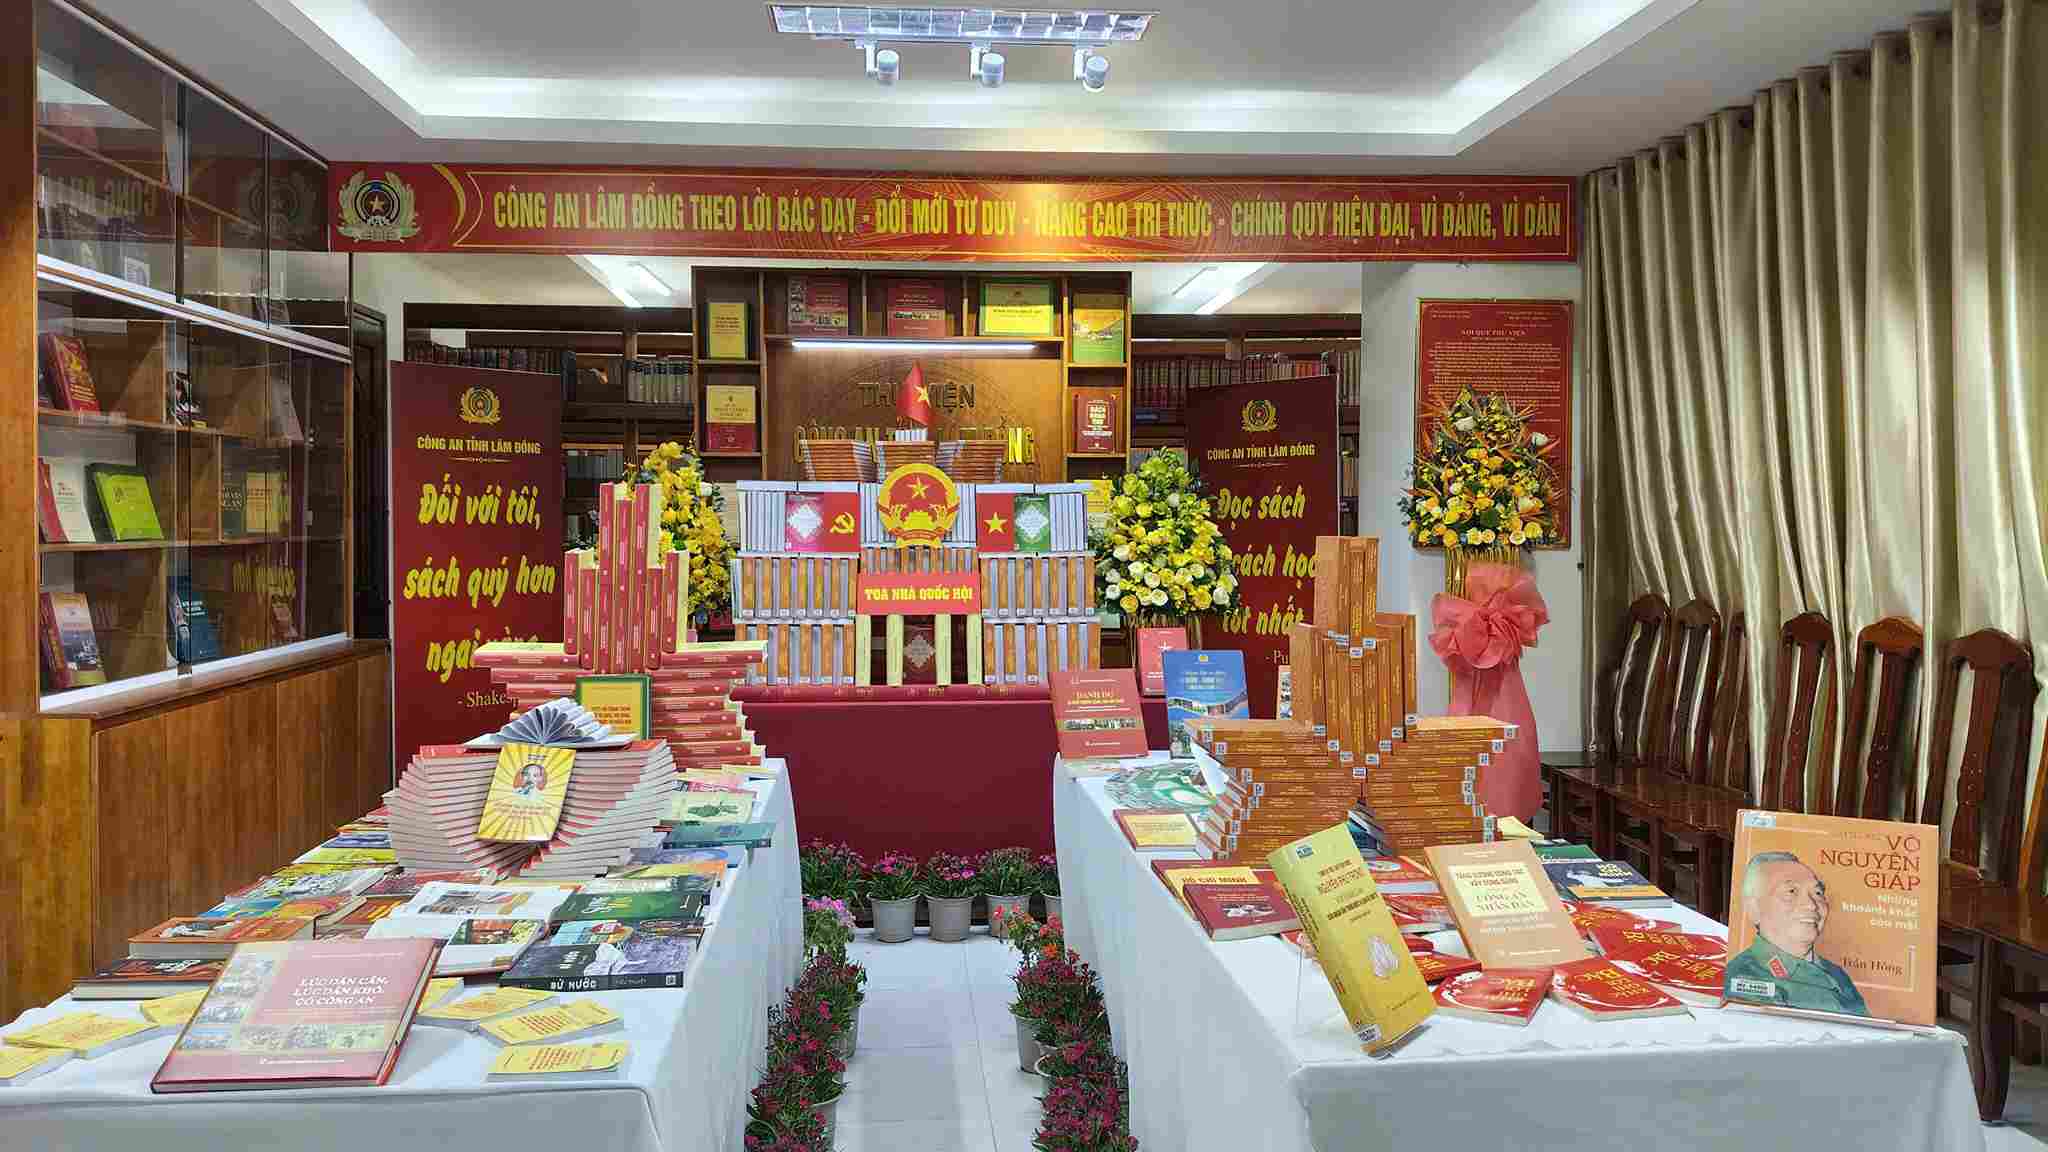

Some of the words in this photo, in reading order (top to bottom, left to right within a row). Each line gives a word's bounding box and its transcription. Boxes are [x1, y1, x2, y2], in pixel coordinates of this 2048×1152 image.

[494, 184, 546, 229] CÔNG
[553, 192, 579, 229] AN
[584, 184, 625, 230] LÂM
[630, 181, 683, 232] ĐỒNG
[689, 194, 736, 231] THEO
[743, 186, 772, 232] LỜI
[777, 188, 815, 232] BÁC
[821, 196, 857, 240] DẠY
[874, 184, 907, 234] ĐỔI
[912, 191, 949, 236] MỚI
[953, 197, 980, 236] TƯ
[982, 199, 1016, 236] DUY
[1092, 200, 1129, 237] CAO
[1134, 200, 1161, 236] TRI
[1167, 194, 1212, 237] THỨC
[1231, 193, 1286, 237] CHÍNH
[1292, 201, 1328, 240] QUY
[1333, 194, 1374, 244] HIỆN
[1380, 201, 1415, 245] ĐẠI,
[1420, 194, 1439, 237] VÌ
[1443, 191, 1497, 240] ĐẢNG,
[1503, 195, 1519, 237] VÌ
[1524, 193, 1561, 238] DÂN
[416, 434, 446, 451] CÔNG
[448, 439, 464, 451] AN
[466, 435, 489, 452] TỈNH
[491, 438, 513, 454] LÂM
[1207, 446, 1230, 461] CÔNG
[1232, 448, 1244, 460] AN
[1268, 443, 1288, 457] LÂM
[418, 472, 462, 525] Đối
[465, 484, 502, 525] với
[506, 485, 541, 530] tôi,
[1217, 487, 1252, 531] Đọc
[1258, 485, 1306, 519] sách
[403, 555, 461, 600] sách
[467, 556, 511, 608] quý
[515, 555, 556, 594] hơn
[1273, 650, 1289, 665] Pu
[1888, 834, 1920, 852] VÕ
[1817, 848, 1920, 872] NGUYÊN
[1863, 871, 1920, 890] GIÁP
